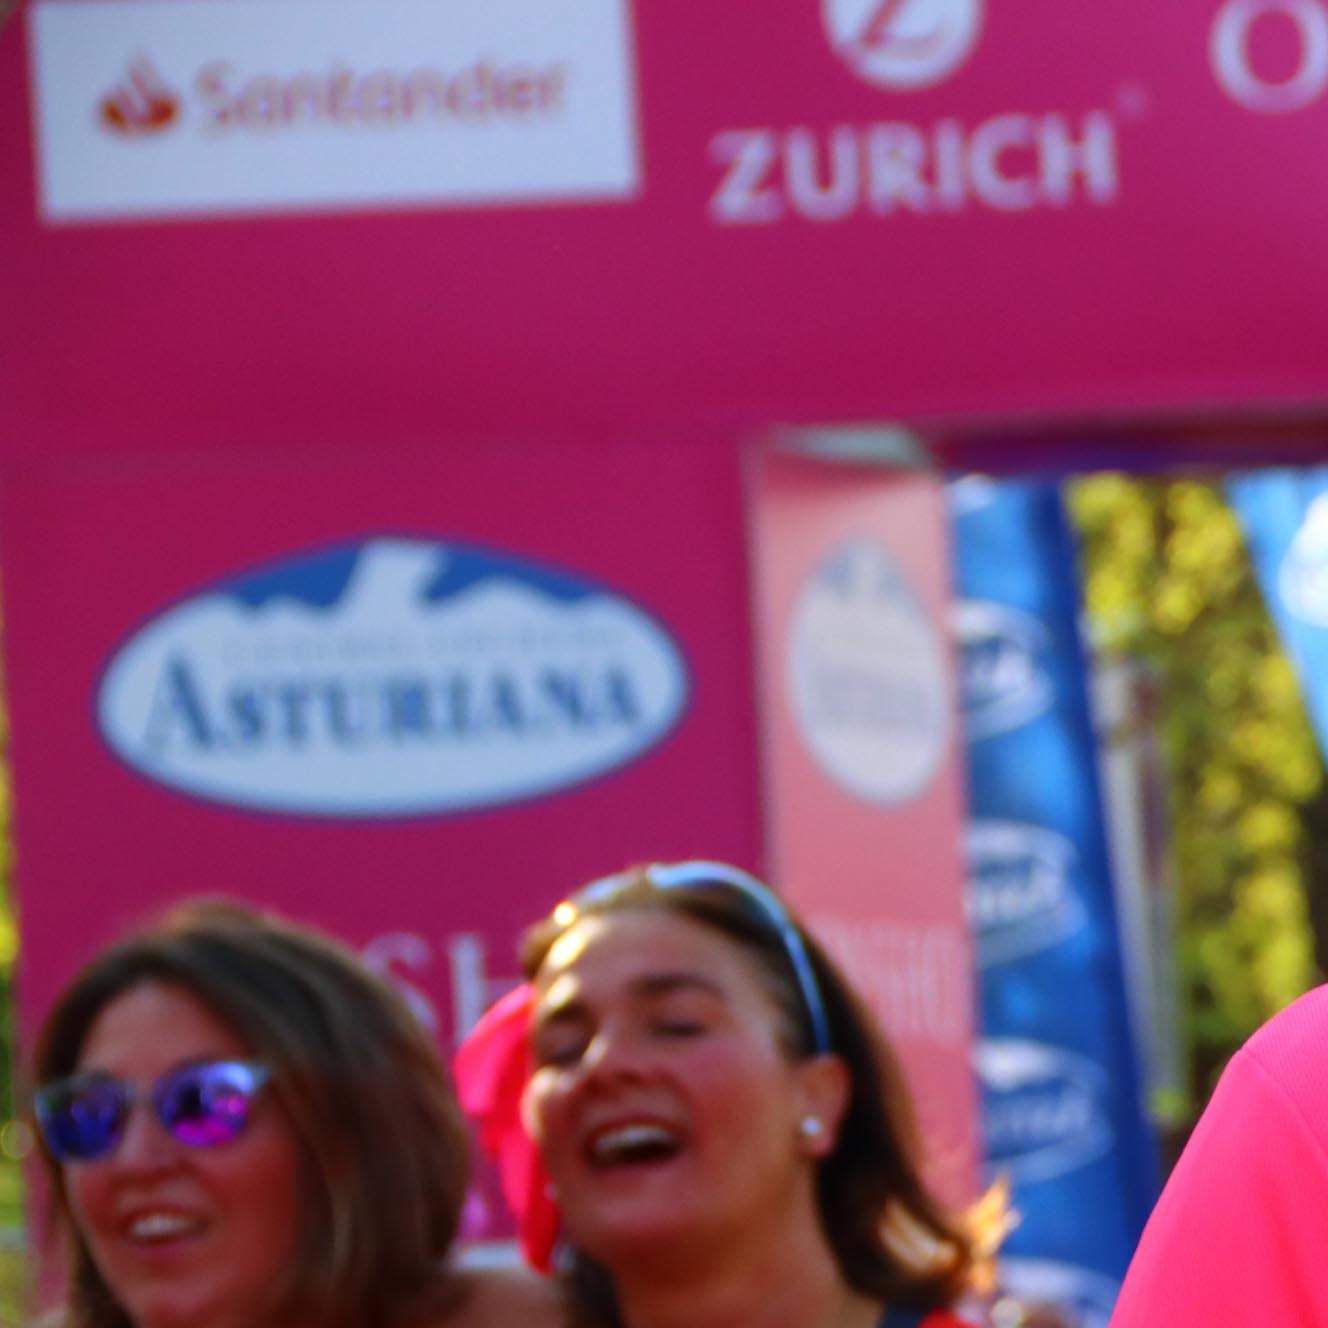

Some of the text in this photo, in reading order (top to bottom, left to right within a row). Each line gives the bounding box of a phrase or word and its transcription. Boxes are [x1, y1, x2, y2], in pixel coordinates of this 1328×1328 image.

[194, 57, 572, 137] Santander
[707, 110, 1117, 226] ZURICH
[142, 648, 642, 750] ASTURIANA
